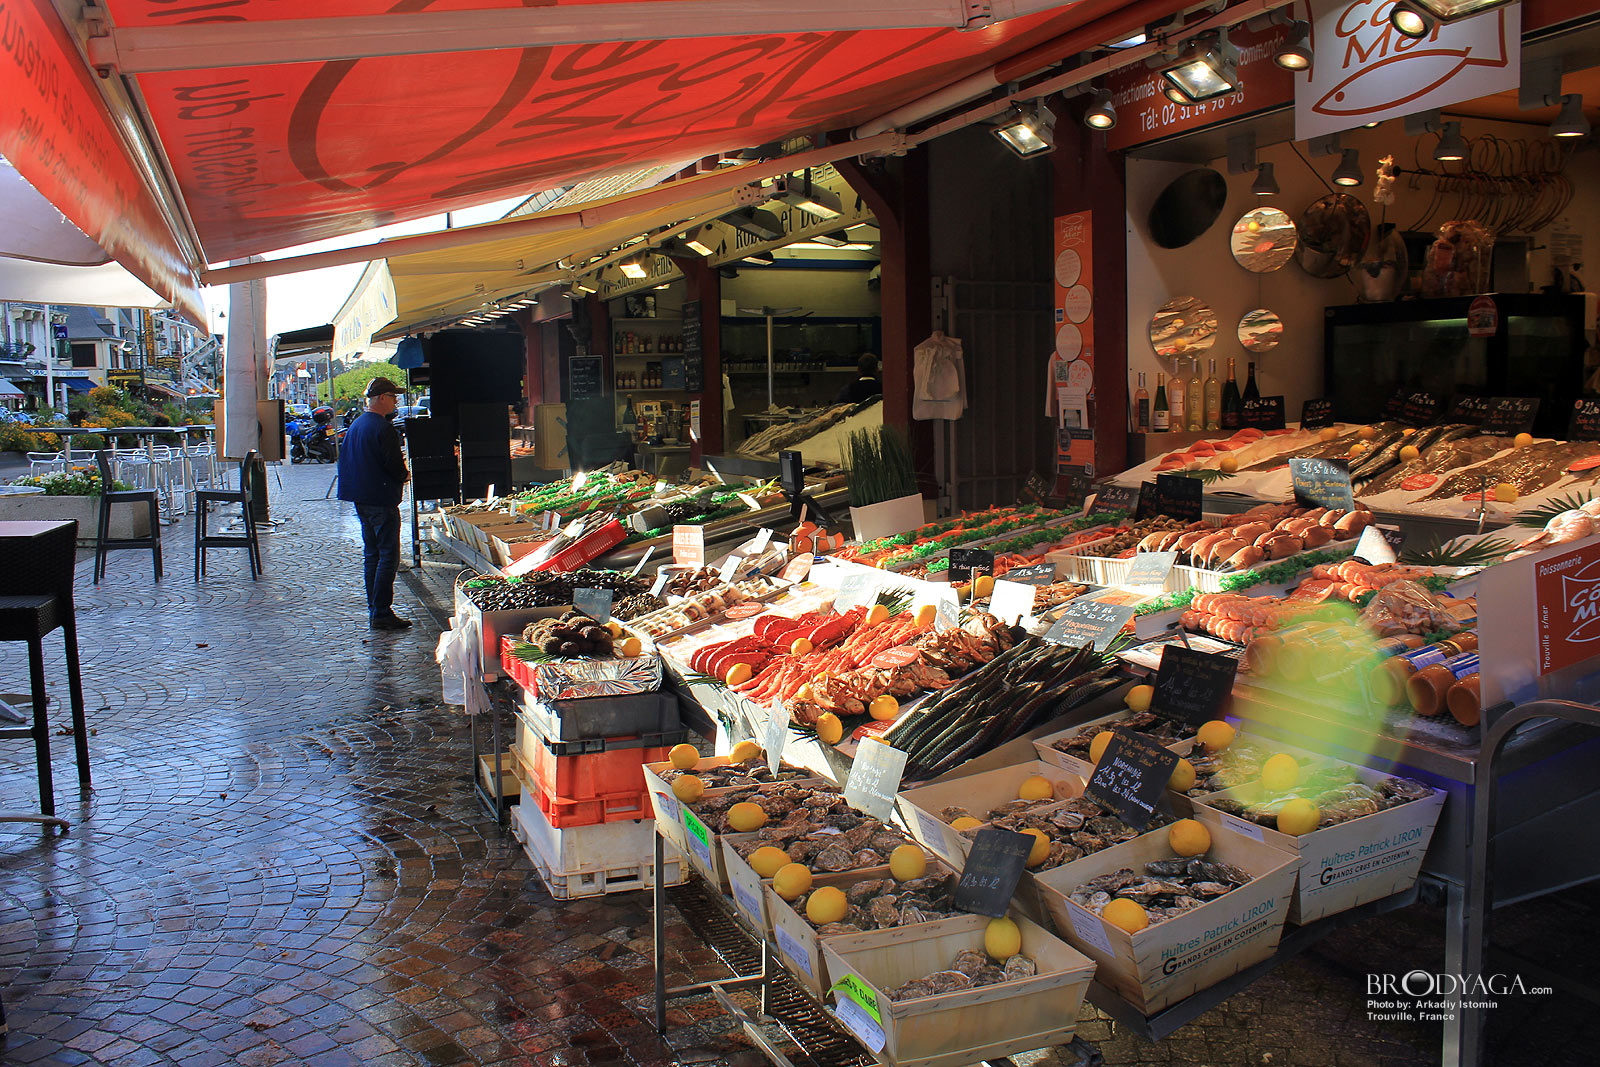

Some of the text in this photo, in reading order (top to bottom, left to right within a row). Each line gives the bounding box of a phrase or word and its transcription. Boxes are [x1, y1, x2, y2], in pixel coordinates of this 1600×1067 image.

[1140, 106, 1159, 131] Tél:
[1162, 102, 1176, 126] 02
[781, 204, 793, 234] et
[1539, 554, 1583, 577] Poissonnerie
[1543, 634, 1551, 669] Trouville
[1320, 826, 1423, 869] Huîtres Patrick LIRON
[1355, 861, 1371, 874] CRUS
[1382, 848, 1411, 865] COTENTIN
[1161, 897, 1275, 961] Huîtres Patrick LIRON
[1203, 943, 1222, 957] CRUS
[1234, 919, 1269, 941] COTENTIN
